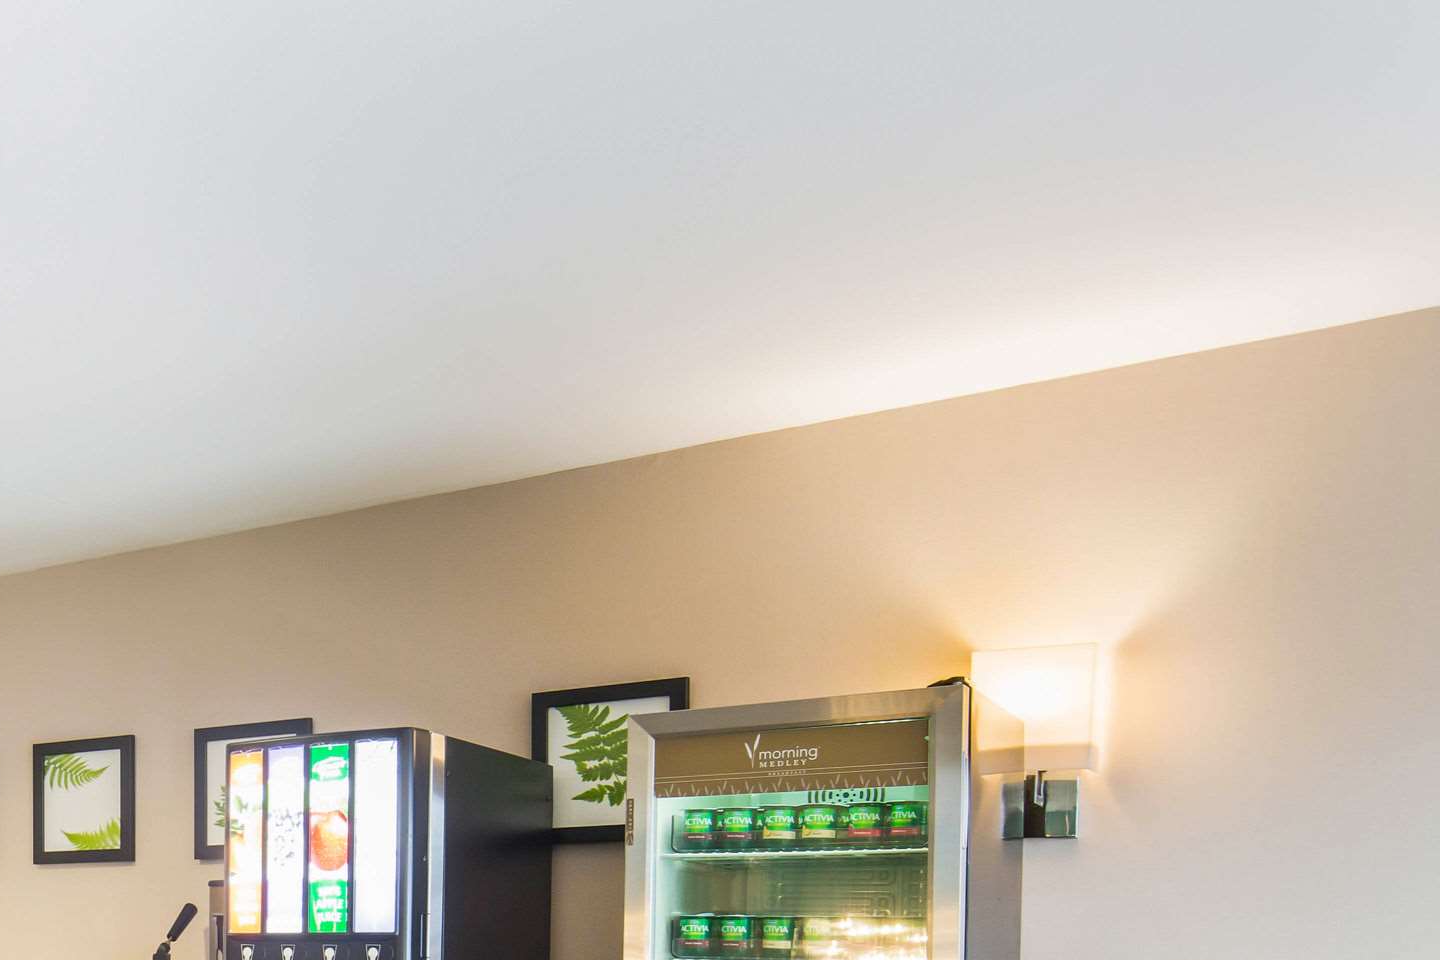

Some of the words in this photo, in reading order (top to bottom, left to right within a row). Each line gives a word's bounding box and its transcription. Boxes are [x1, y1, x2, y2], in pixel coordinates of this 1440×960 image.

[759, 745, 818, 761] morning
[759, 759, 808, 769] MEDLEY
[804, 814, 835, 823] ACTIVIA
[890, 810, 917, 819] CTIVIA
[724, 815, 753, 825] ACTIVIA
[766, 815, 795, 824] ACTIVIA
[721, 925, 747, 934] CTIVIA
[763, 925, 789, 934] CTIVIA
